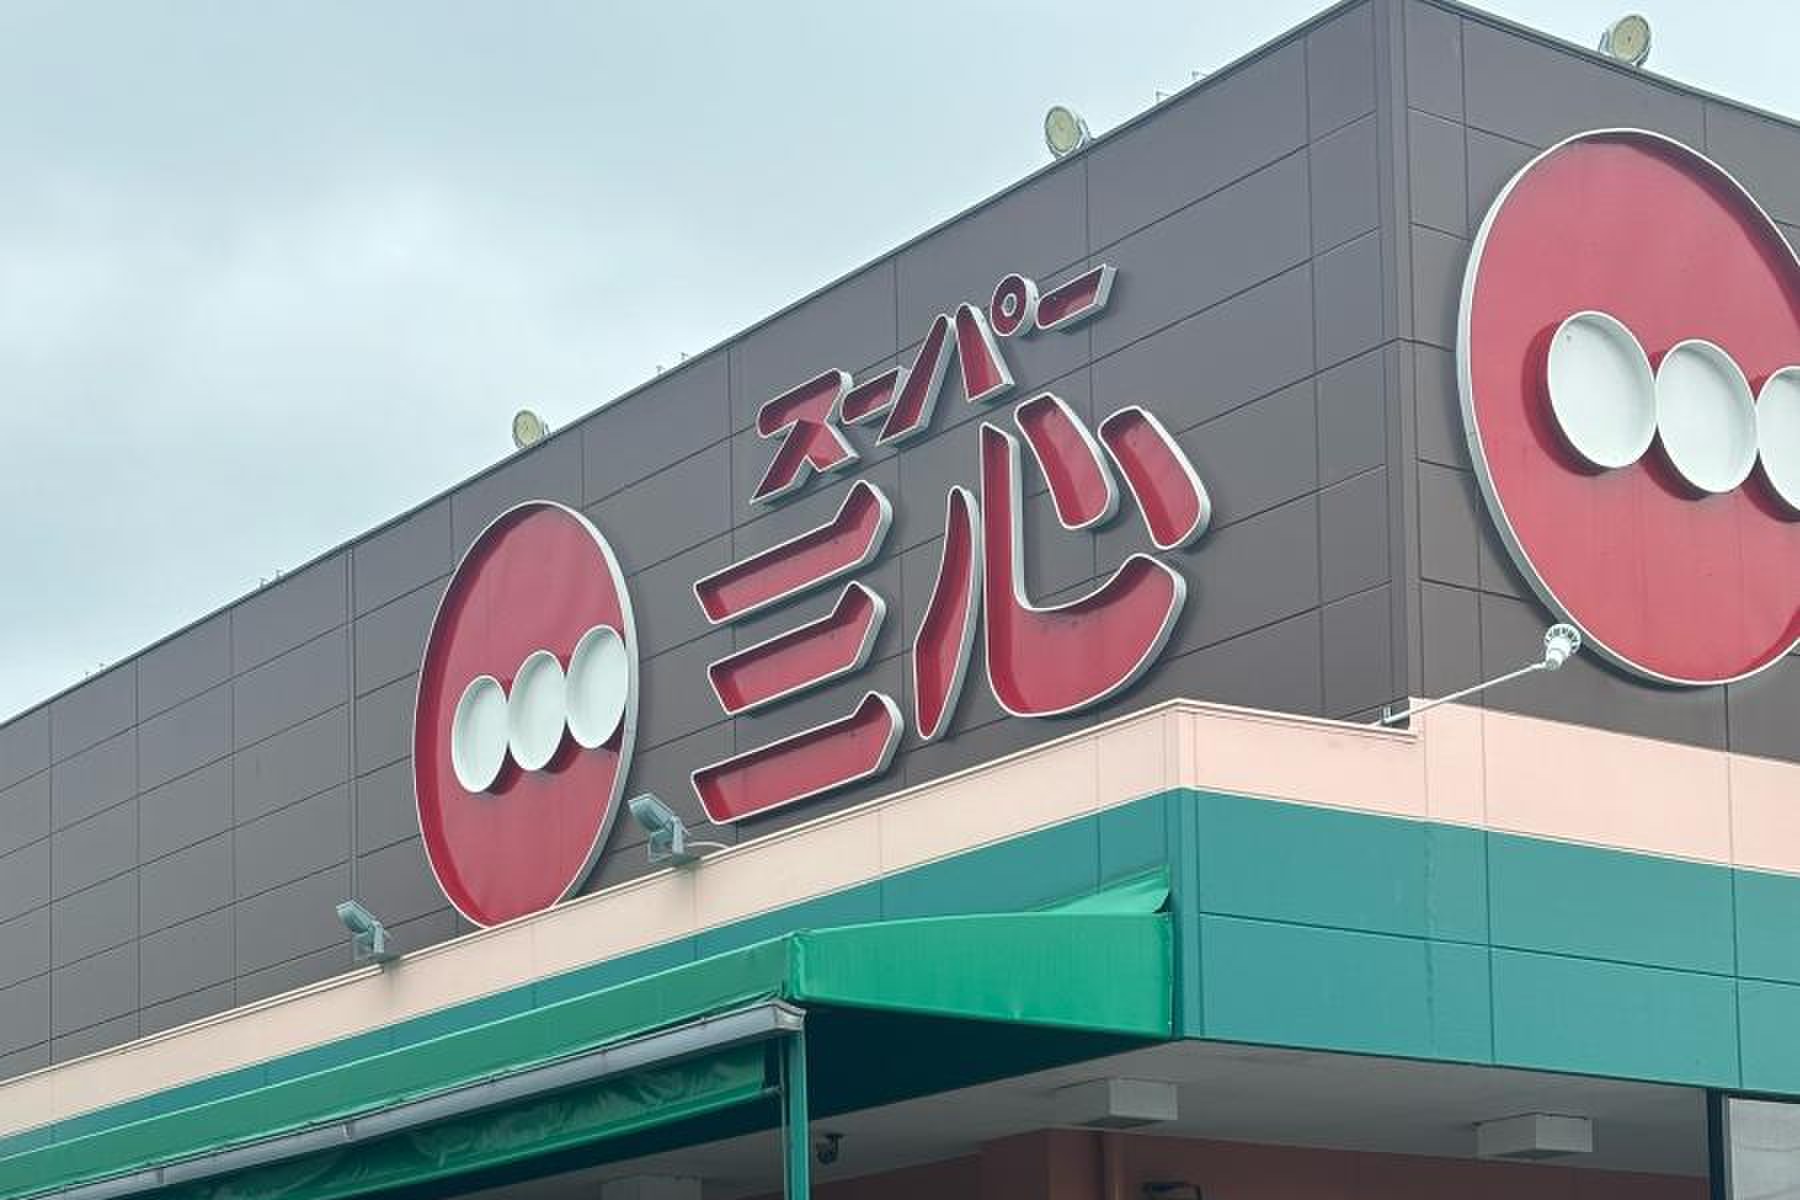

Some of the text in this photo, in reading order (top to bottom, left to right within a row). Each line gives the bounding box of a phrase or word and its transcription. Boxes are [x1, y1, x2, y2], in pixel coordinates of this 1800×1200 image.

[750, 263, 1118, 506] スーパー
[691, 392, 1212, 826] 三心
